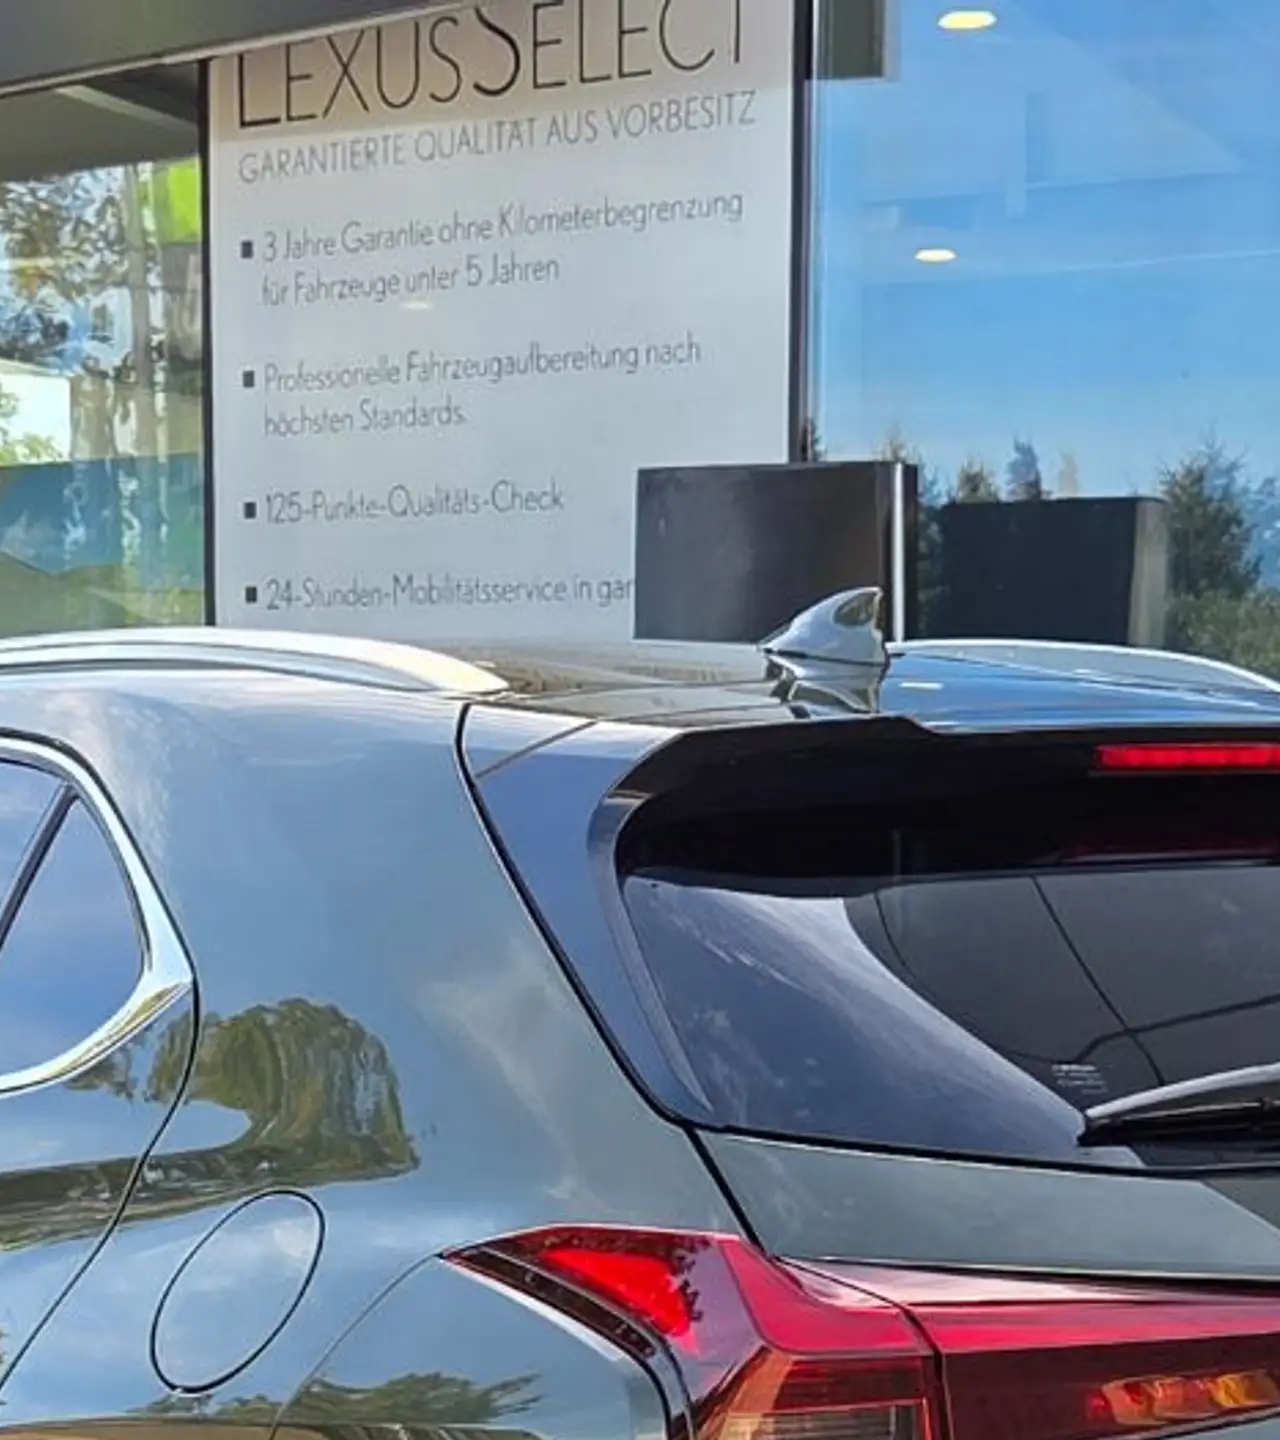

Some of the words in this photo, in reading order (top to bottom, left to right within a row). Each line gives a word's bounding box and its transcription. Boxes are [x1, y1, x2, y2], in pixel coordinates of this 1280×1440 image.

[238, 131, 406, 184] GARANTIERTE
[546, 109, 599, 147] AUS
[605, 89, 757, 140] VORBESITZ
[262, 229, 278, 263] 3
[282, 227, 337, 261] Jahre
[341, 219, 434, 254] Garantie
[437, 208, 493, 245] ohne
[498, 193, 744, 240] Kilometerbegrenzung
[293, 268, 402, 304] Fahrzeuge
[405, 264, 460, 293] unter
[465, 253, 484, 288] 5
[487, 250, 560, 286] Jahren
[263, 355, 402, 393] Professionelle
[644, 330, 701, 364] nach
[572, 572, 593, 602] in
